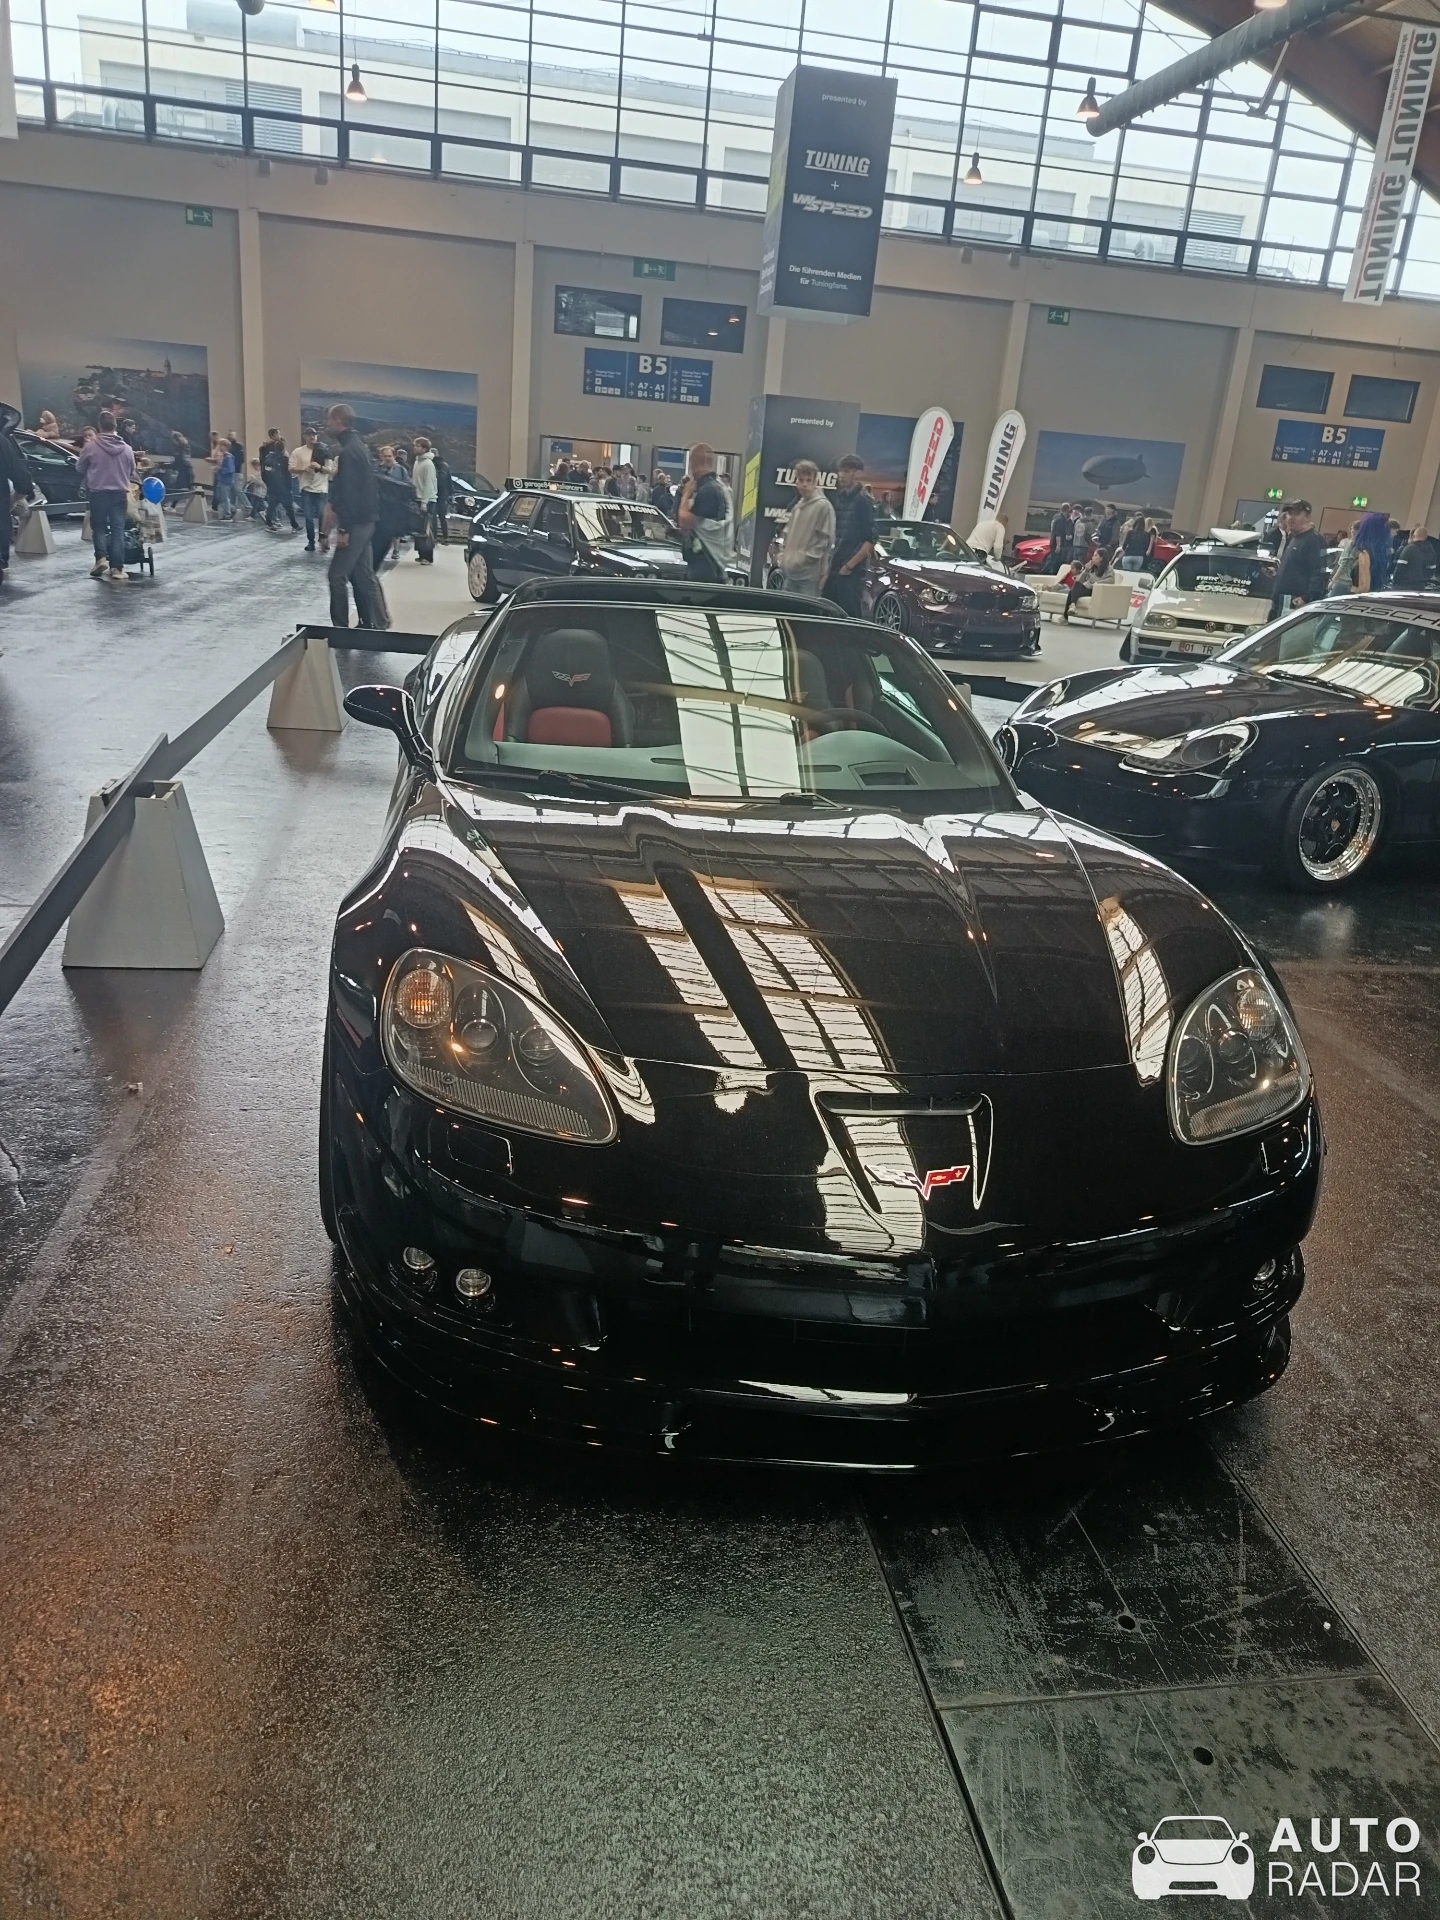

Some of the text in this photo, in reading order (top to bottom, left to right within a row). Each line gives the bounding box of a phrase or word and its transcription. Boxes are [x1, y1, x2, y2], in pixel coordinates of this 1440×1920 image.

[822, 93, 868, 108] presented by
[805, 150, 870, 175] TUNING
[803, 199, 873, 219] SPEED
[789, 264, 862, 281] Die führenden Medien
[800, 277, 810, 285] für
[638, 355, 667, 376] B5
[637, 382, 649, 390] A7
[654, 384, 665, 392] A1
[637, 390, 648, 398] B4
[654, 391, 665, 399] B1
[790, 416, 834, 428] presented by
[1321, 426, 1347, 445] B5
[917, 416, 944, 505] SPEED
[1318, 449, 1328, 457] A7
[1332, 450, 1342, 458] A1
[983, 422, 1017, 511] TUNING
[776, 467, 839, 488] TUNG
[622, 504, 659, 516] RACING
[1315, 602, 1440, 627] PORSCH
[1184, 643, 1214, 655] 01 TR
